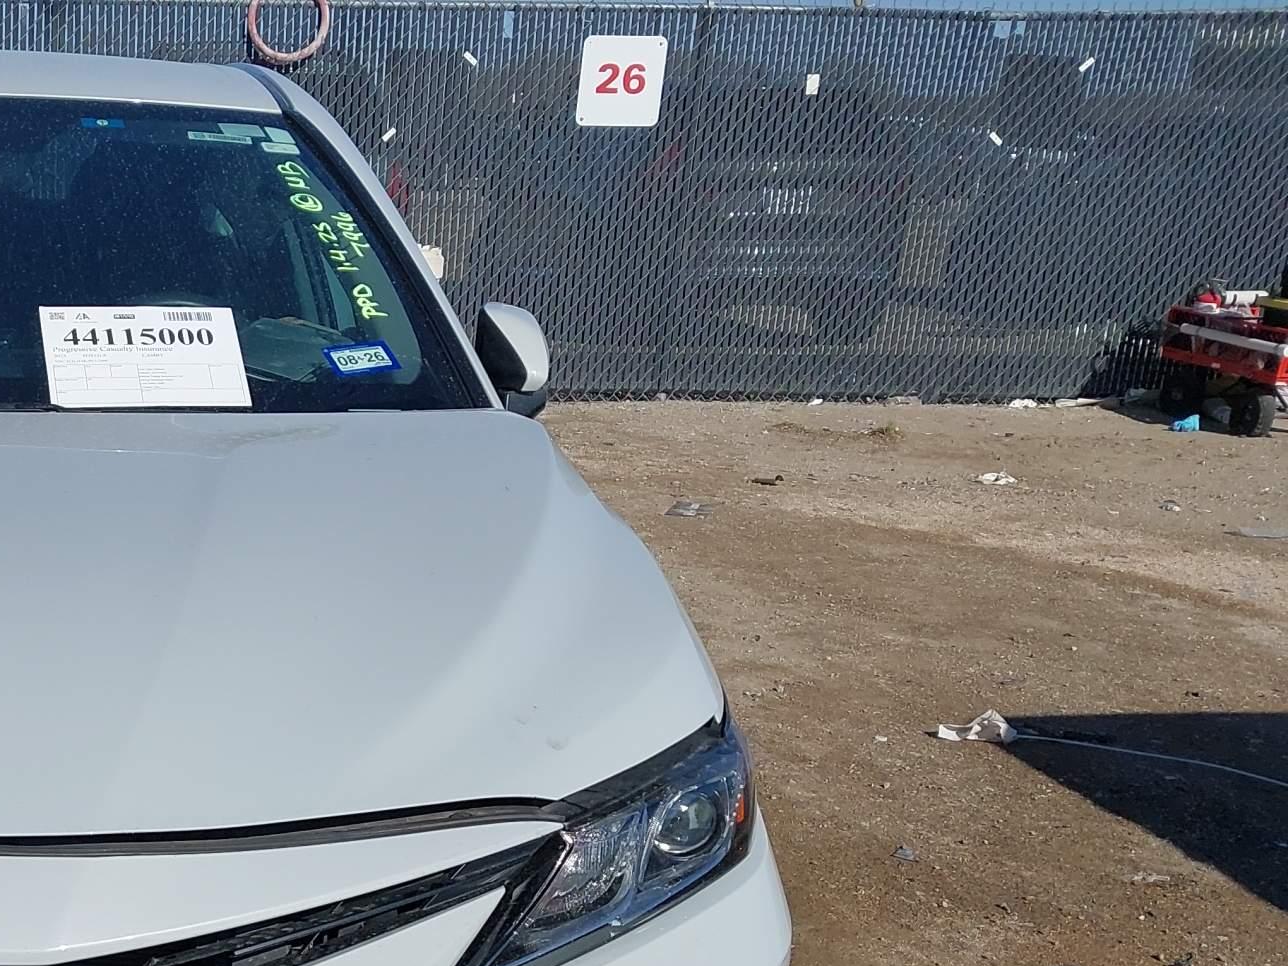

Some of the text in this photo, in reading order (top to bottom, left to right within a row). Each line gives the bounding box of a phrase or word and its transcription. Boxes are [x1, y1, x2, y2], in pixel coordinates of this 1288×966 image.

[595, 63, 647, 95] 26
[63, 327, 214, 346] 44115000
[336, 351, 385, 367] 08 26
